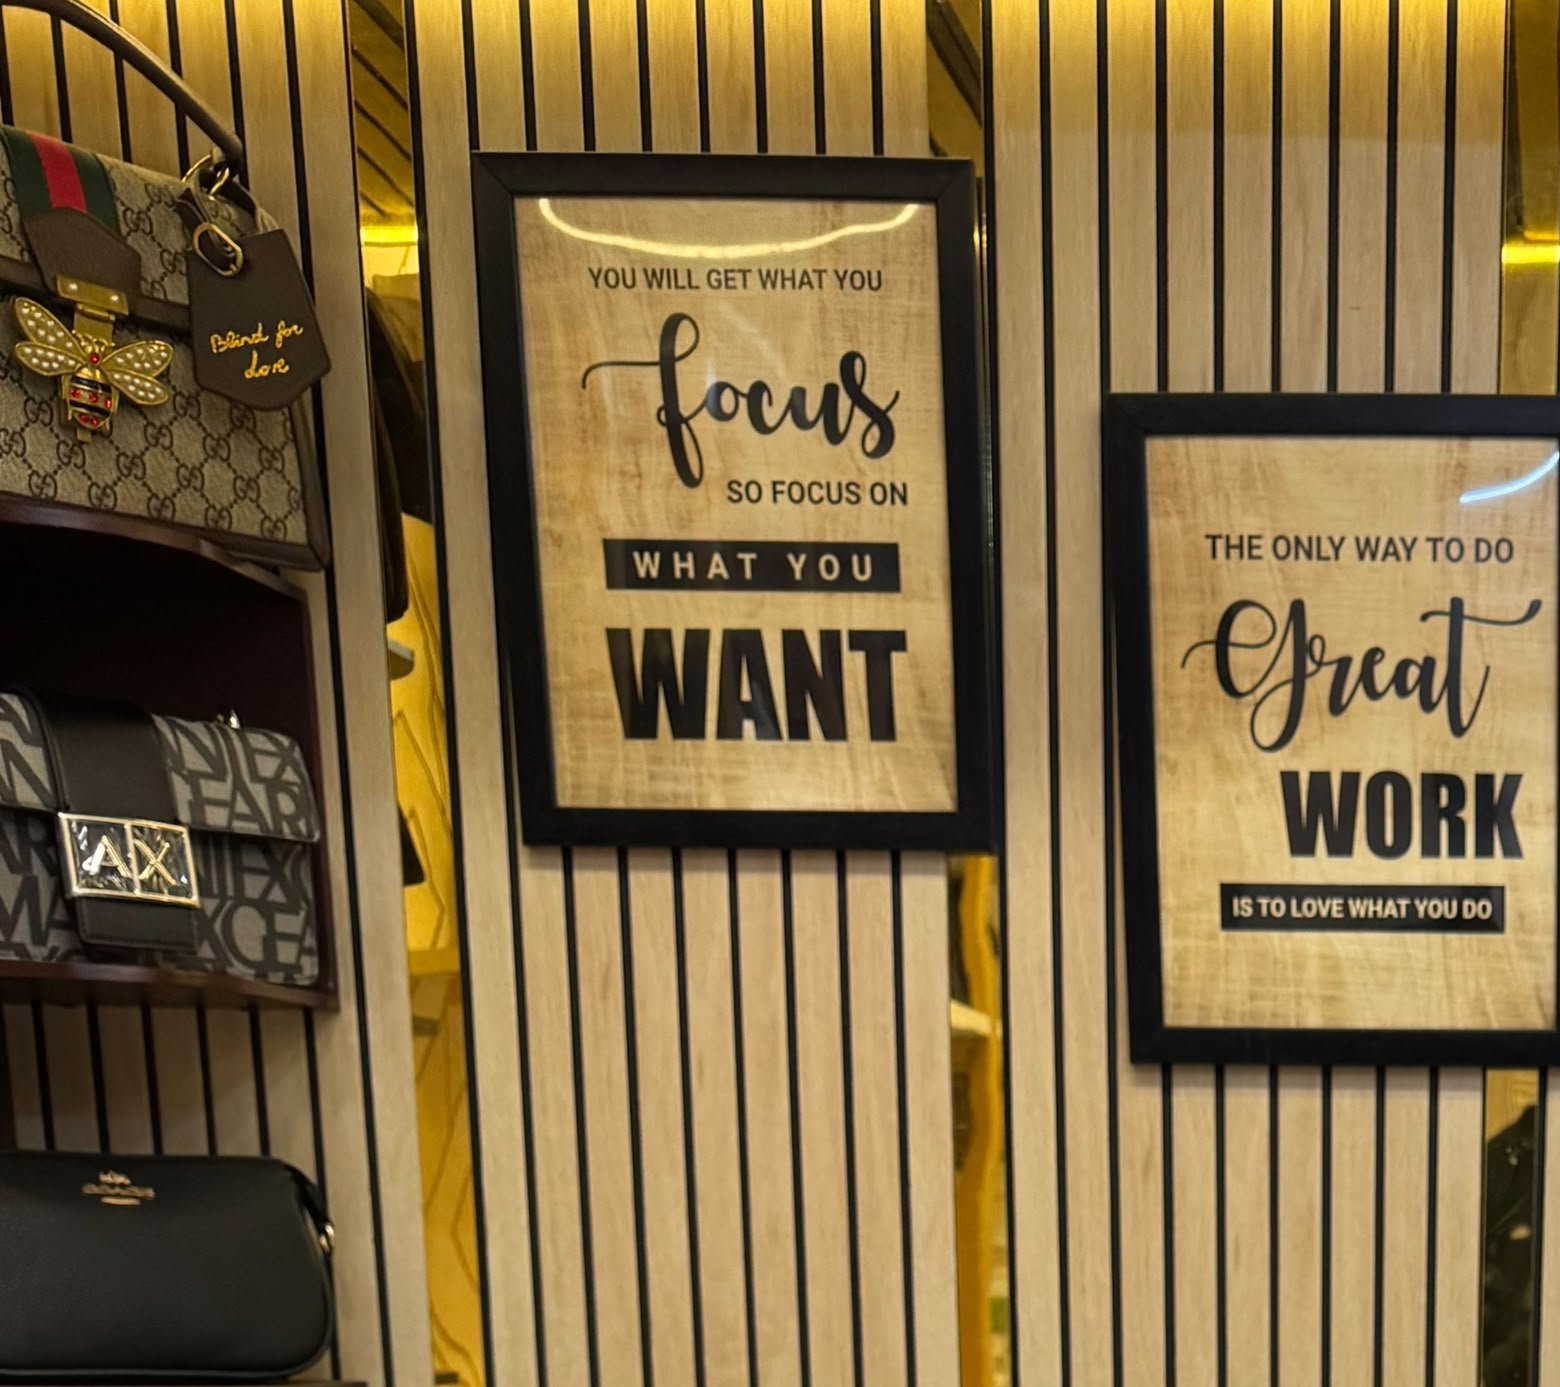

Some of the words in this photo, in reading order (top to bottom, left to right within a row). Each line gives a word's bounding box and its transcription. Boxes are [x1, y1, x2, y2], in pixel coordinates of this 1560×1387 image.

[588, 267, 637, 290] YOU
[644, 267, 700, 290] WILL
[706, 268, 753, 290] GET
[758, 268, 828, 291] WHAT
[834, 269, 883, 291] YOU
[210, 322, 269, 354] Blind
[275, 320, 304, 349] for
[581, 312, 900, 489] focus
[727, 480, 763, 503] SO
[771, 480, 862, 506] FOCUS
[869, 482, 909, 506] ON
[1204, 534, 1264, 562] THE
[1271, 535, 1346, 562] ONLY
[1354, 536, 1418, 563] WAY
[1425, 537, 1465, 563] TO
[1474, 538, 1515, 563] DO
[632, 551, 758, 580] WHAT
[786, 553, 873, 582] YOU
[605, 627, 908, 742] WANT
[1181, 597, 1542, 754] Great
[1280, 770, 1525, 861] WORK
[1231, 896, 1254, 918] IS
[1256, 897, 1287, 918] TO
[1291, 897, 1345, 919] LOVE
[1348, 898, 1411, 920] WHAT
[1414, 899, 1458, 921] YOU
[1462, 899, 1494, 921] DO
